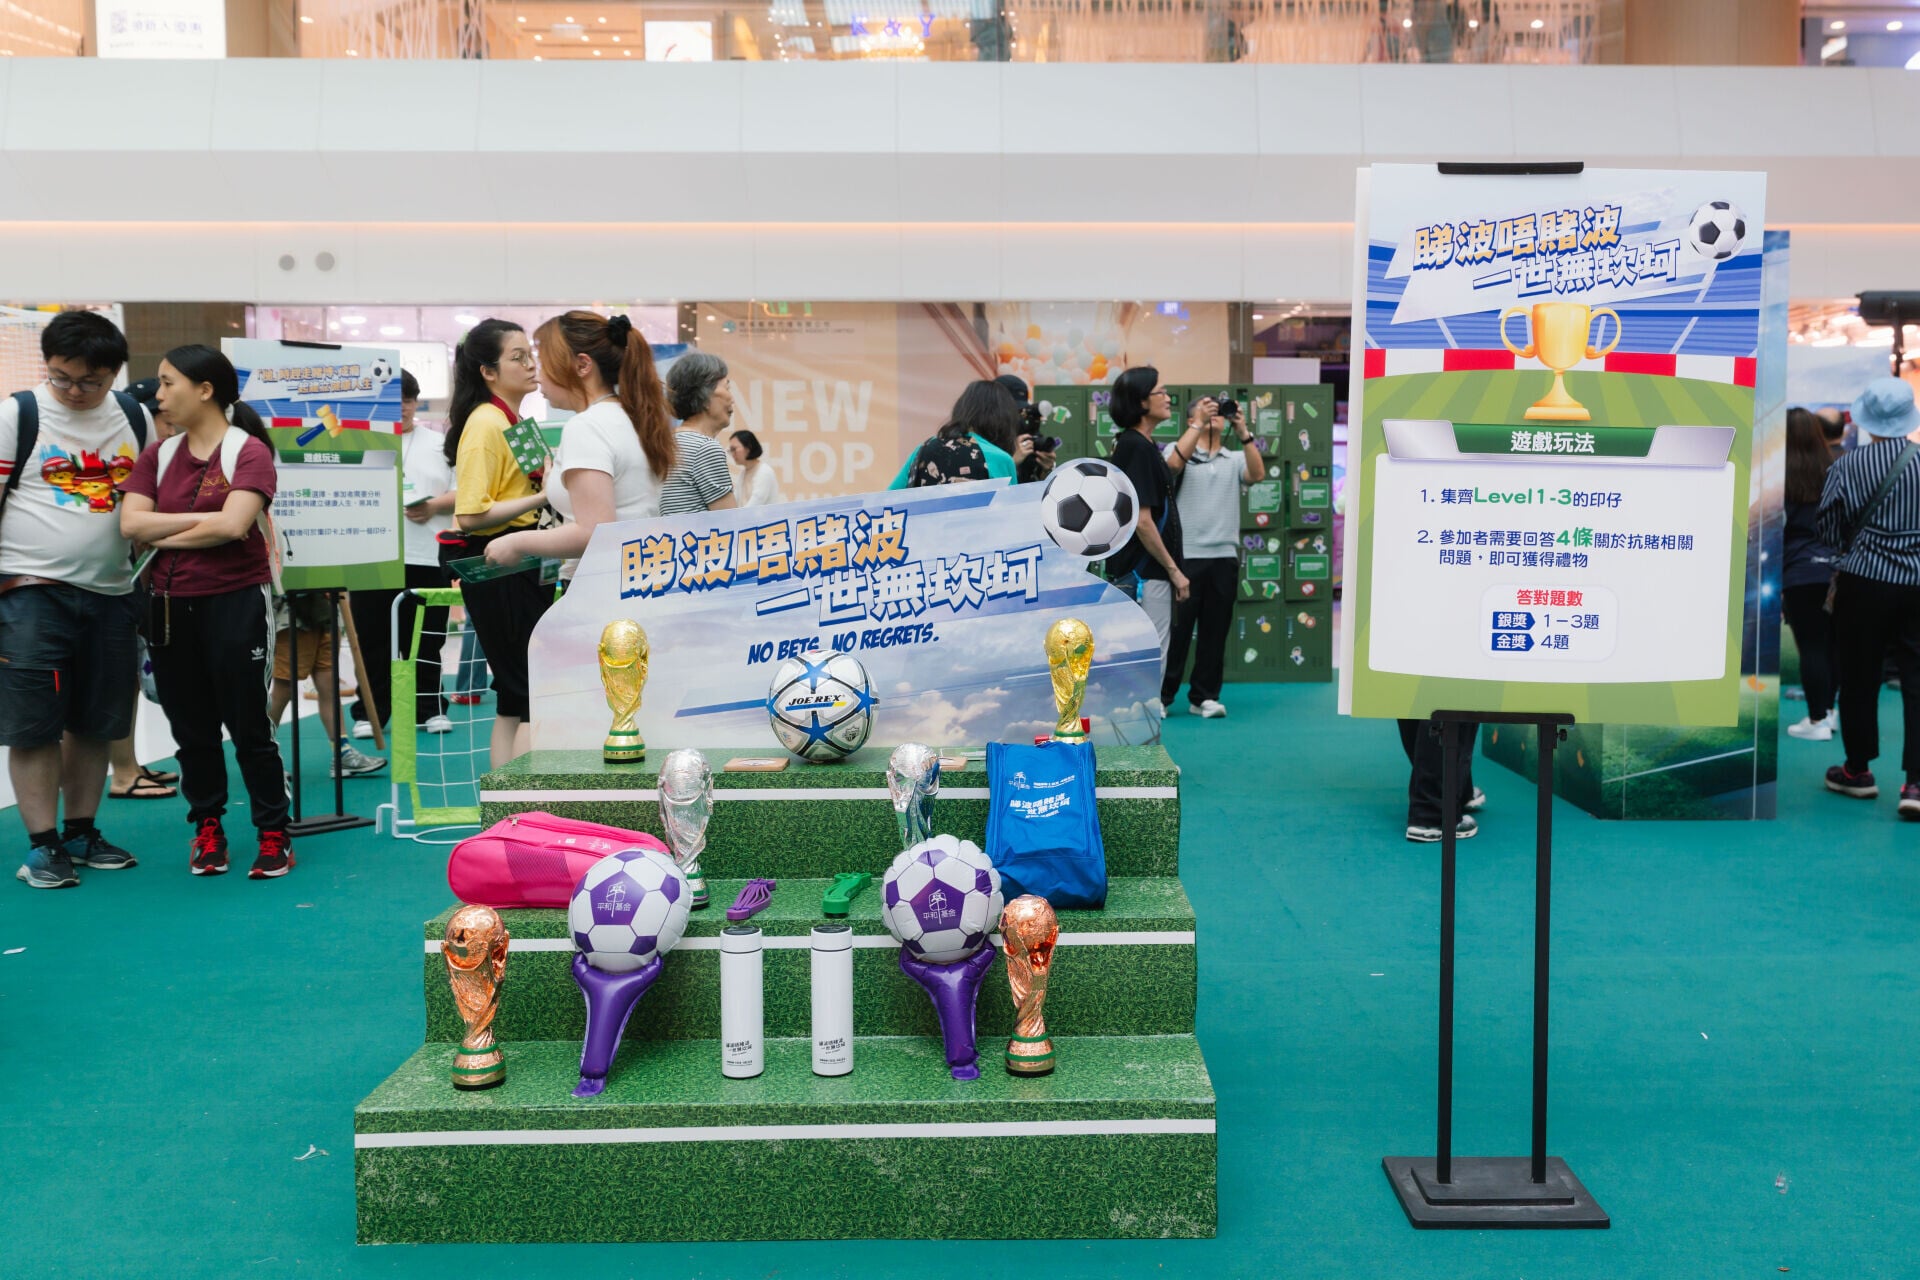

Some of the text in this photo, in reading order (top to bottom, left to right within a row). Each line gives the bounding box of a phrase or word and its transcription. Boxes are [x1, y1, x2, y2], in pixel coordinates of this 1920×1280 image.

[919, 13, 936, 38] Y
[1413, 204, 1622, 271] 睇波唔賭波
[1472, 238, 1681, 298] 一世無坎坷
[723, 379, 873, 433] NEW
[728, 441, 875, 485] HOP
[1510, 430, 1595, 454] 遊戲玩法
[620, 507, 909, 600] 睇波唔賭波
[755, 544, 1044, 627] 一世無坎坷
[1516, 588, 1584, 608] 答對題數
[1497, 612, 1528, 629] 銀獎
[747, 641, 774, 665] NO
[831, 630, 857, 653] NO
[859, 622, 940, 650] REGRETS.
[1496, 634, 1570, 651] 金獎 4題
[788, 696, 813, 706] JOE
